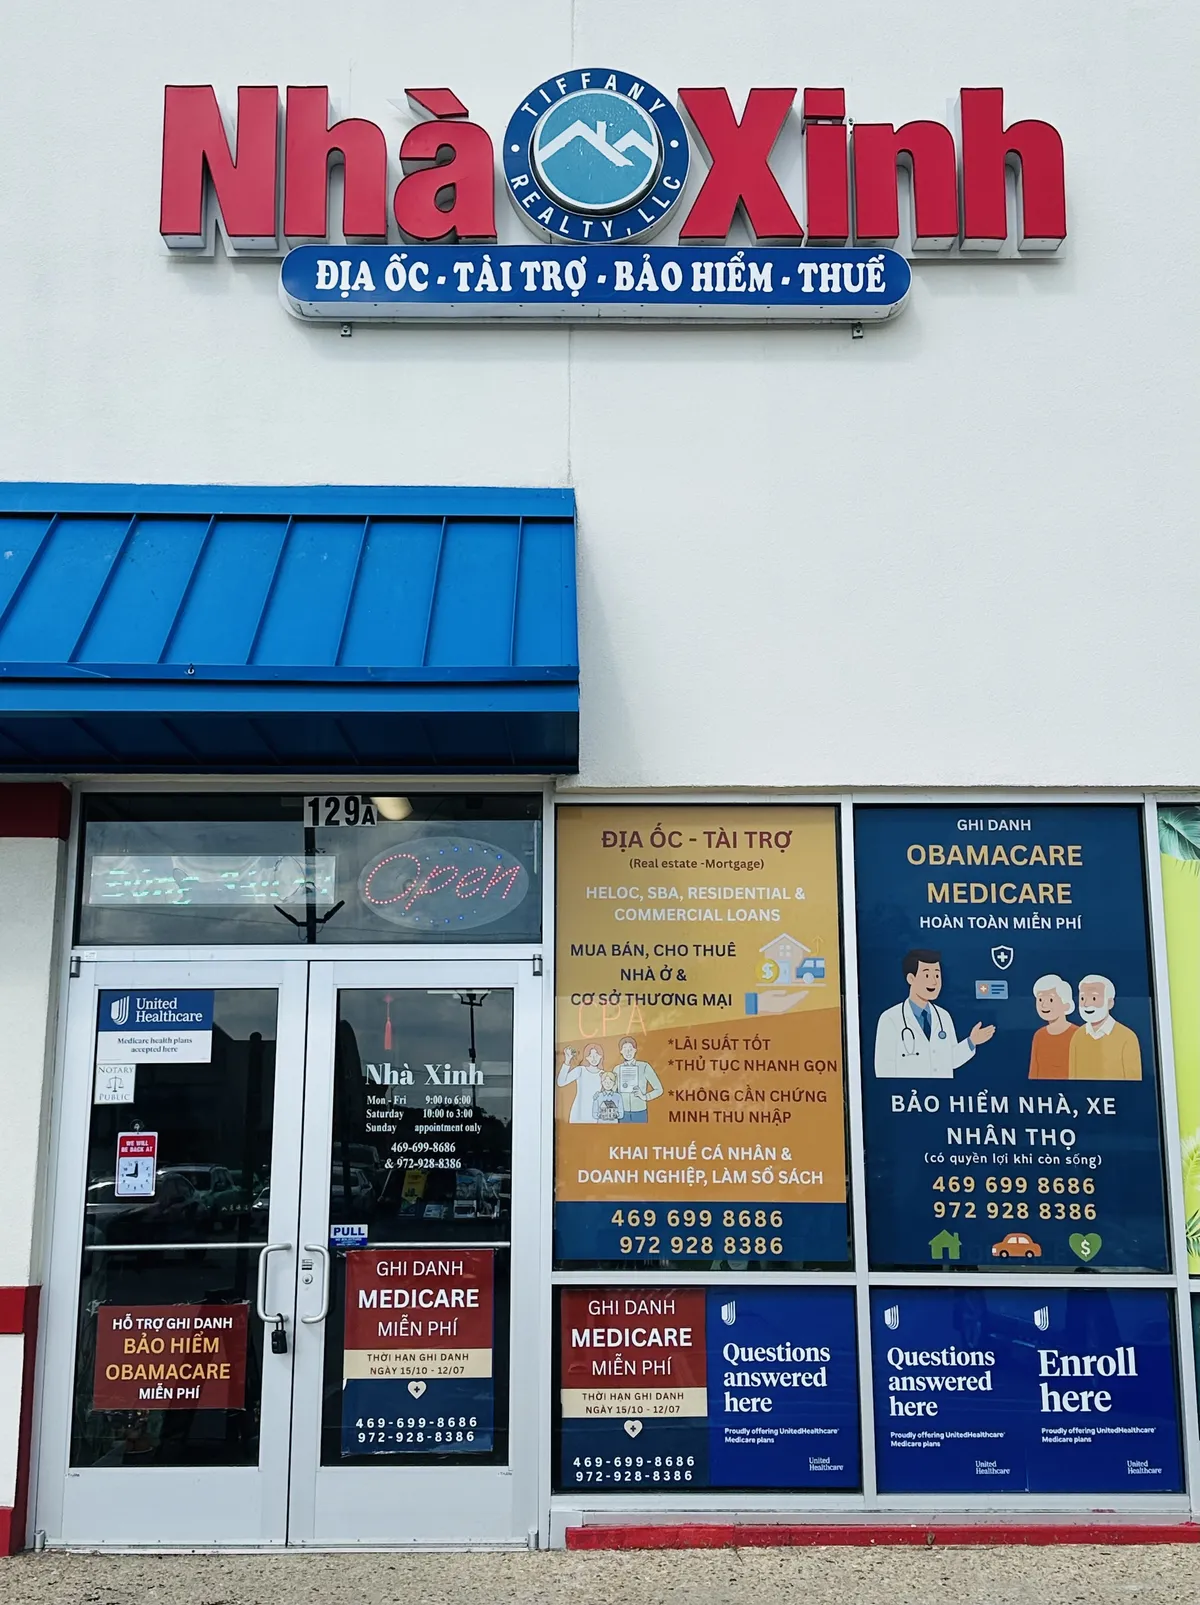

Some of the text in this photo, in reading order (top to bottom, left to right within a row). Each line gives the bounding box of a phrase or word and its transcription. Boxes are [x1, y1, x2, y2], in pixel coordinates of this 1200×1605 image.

[521, 72, 665, 117] TIFFANY
[159, 85, 1068, 247] Nhà Xinh
[511, 173, 681, 238] REALTY, LLC
[315, 250, 886, 298] ĐỊA ỐC TÀI TRỢ BẢO HIỂM THUẾ
[308, 796, 375, 826] 129A
[957, 819, 1031, 831] GHI DANH
[602, 823, 793, 853] ĐỊA ỐC TÀI TRỢ
[629, 858, 765, 871] (Real estate -Mortgage)
[907, 845, 1083, 866] OBAMACARE
[364, 852, 522, 910] Open
[586, 886, 806, 901] HELOC, SBA, RESIDENTIAL &
[927, 883, 1072, 904] MEDICARE
[614, 909, 780, 922] COMMERCIAL LOANS
[920, 912, 1082, 929] HOÀN TOÀN MIỄN PHÍ
[571, 941, 736, 959] MUA BÁN, CHO THUÊ
[620, 965, 687, 981] NHÀ Ở &
[136, 997, 177, 1009] United
[571, 989, 732, 1009] CƠ SỞ THƯƠNG MẠI
[135, 1011, 203, 1022] Healthcare
[174, 1037, 192, 1046] plans
[702, 1032, 739, 1051] SUẤT
[743, 1033, 771, 1051] TỐT
[365, 1063, 484, 1085] Nhà Xinh
[711, 1060, 739, 1074] TỤC
[744, 1060, 799, 1071] NHANH
[804, 1060, 837, 1074] GỌN
[367, 1095, 471, 1104] Mon Fri 9:00 to 6:00
[734, 1084, 765, 1102] CẦN
[770, 1088, 827, 1102] CHỨNG
[891, 1089, 1117, 1118] BẢO HIỂM NHÀ, XE
[366, 1109, 473, 1120] Saturday 10:00 to 3:00
[669, 1109, 791, 1126] MINH THU NHẬP
[366, 1122, 482, 1134] Sunday appointment only
[948, 1124, 1076, 1150] NHÂN THỌ
[391, 1142, 456, 1152] 469-699-8686
[609, 1140, 792, 1160] KHAI THUẾ CÁ NHÂN &
[385, 1158, 461, 1168] & 972-928-8386
[924, 1151, 1102, 1169] (có quyền lợi khi còn sống)
[578, 1163, 823, 1186] DOANH NGHIỆP, LÀM SỔ SÁCH
[933, 1176, 1095, 1194] 469 699 8686
[334, 1227, 364, 1236] PULL
[376, 1261, 463, 1276] GHI DANH
[358, 1288, 479, 1309] MEDICARE
[113, 1313, 232, 1332] HỖ TRỢ GHI DANH
[378, 1315, 458, 1336] MIỄN PHÍ
[124, 1331, 220, 1354] BẢO HIỂM
[571, 1328, 692, 1347] MEDICARE
[367, 1351, 469, 1365] THỜI HẠN GHI DANH
[722, 1342, 830, 1365] Questions
[1037, 1346, 1138, 1378] Enroll
[105, 1363, 231, 1380] OBAMACARE
[370, 1364, 465, 1376] NGÀY 15/10 12/07
[723, 1367, 828, 1387] answered
[139, 1383, 200, 1399] MIỄN PHÍ
[1040, 1383, 1112, 1413] here
[724, 1392, 772, 1413] here
[724, 1428, 750, 1436] Proudly
[751, 1428, 778, 1436] offering
[757, 1437, 774, 1445] plans
